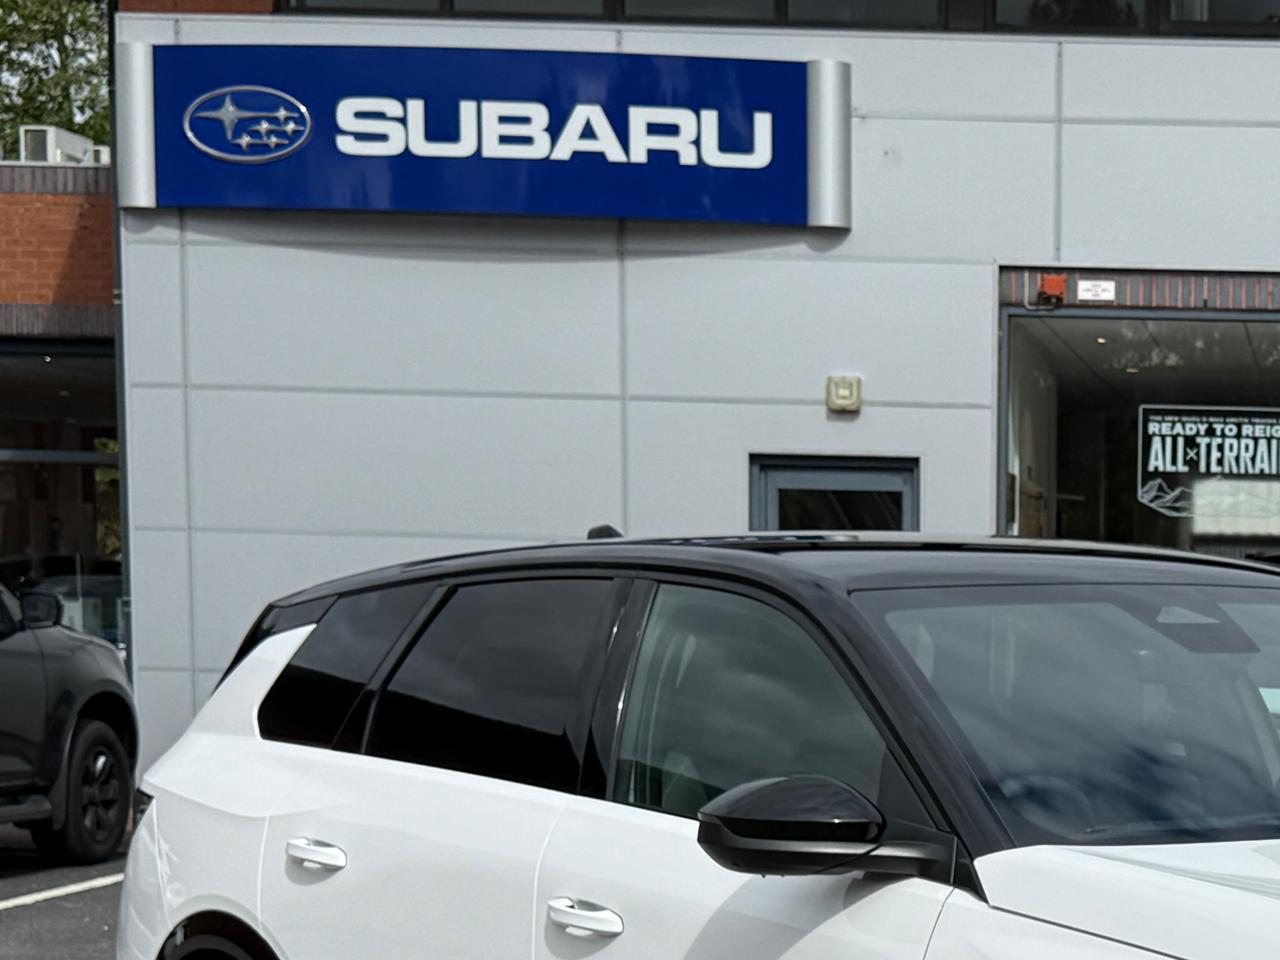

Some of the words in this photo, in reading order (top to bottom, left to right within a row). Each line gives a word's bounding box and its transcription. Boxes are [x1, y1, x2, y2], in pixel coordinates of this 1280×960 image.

[335, 96, 773, 169] SUBARU
[1147, 421, 1209, 436] READY
[1212, 423, 1238, 437] TO
